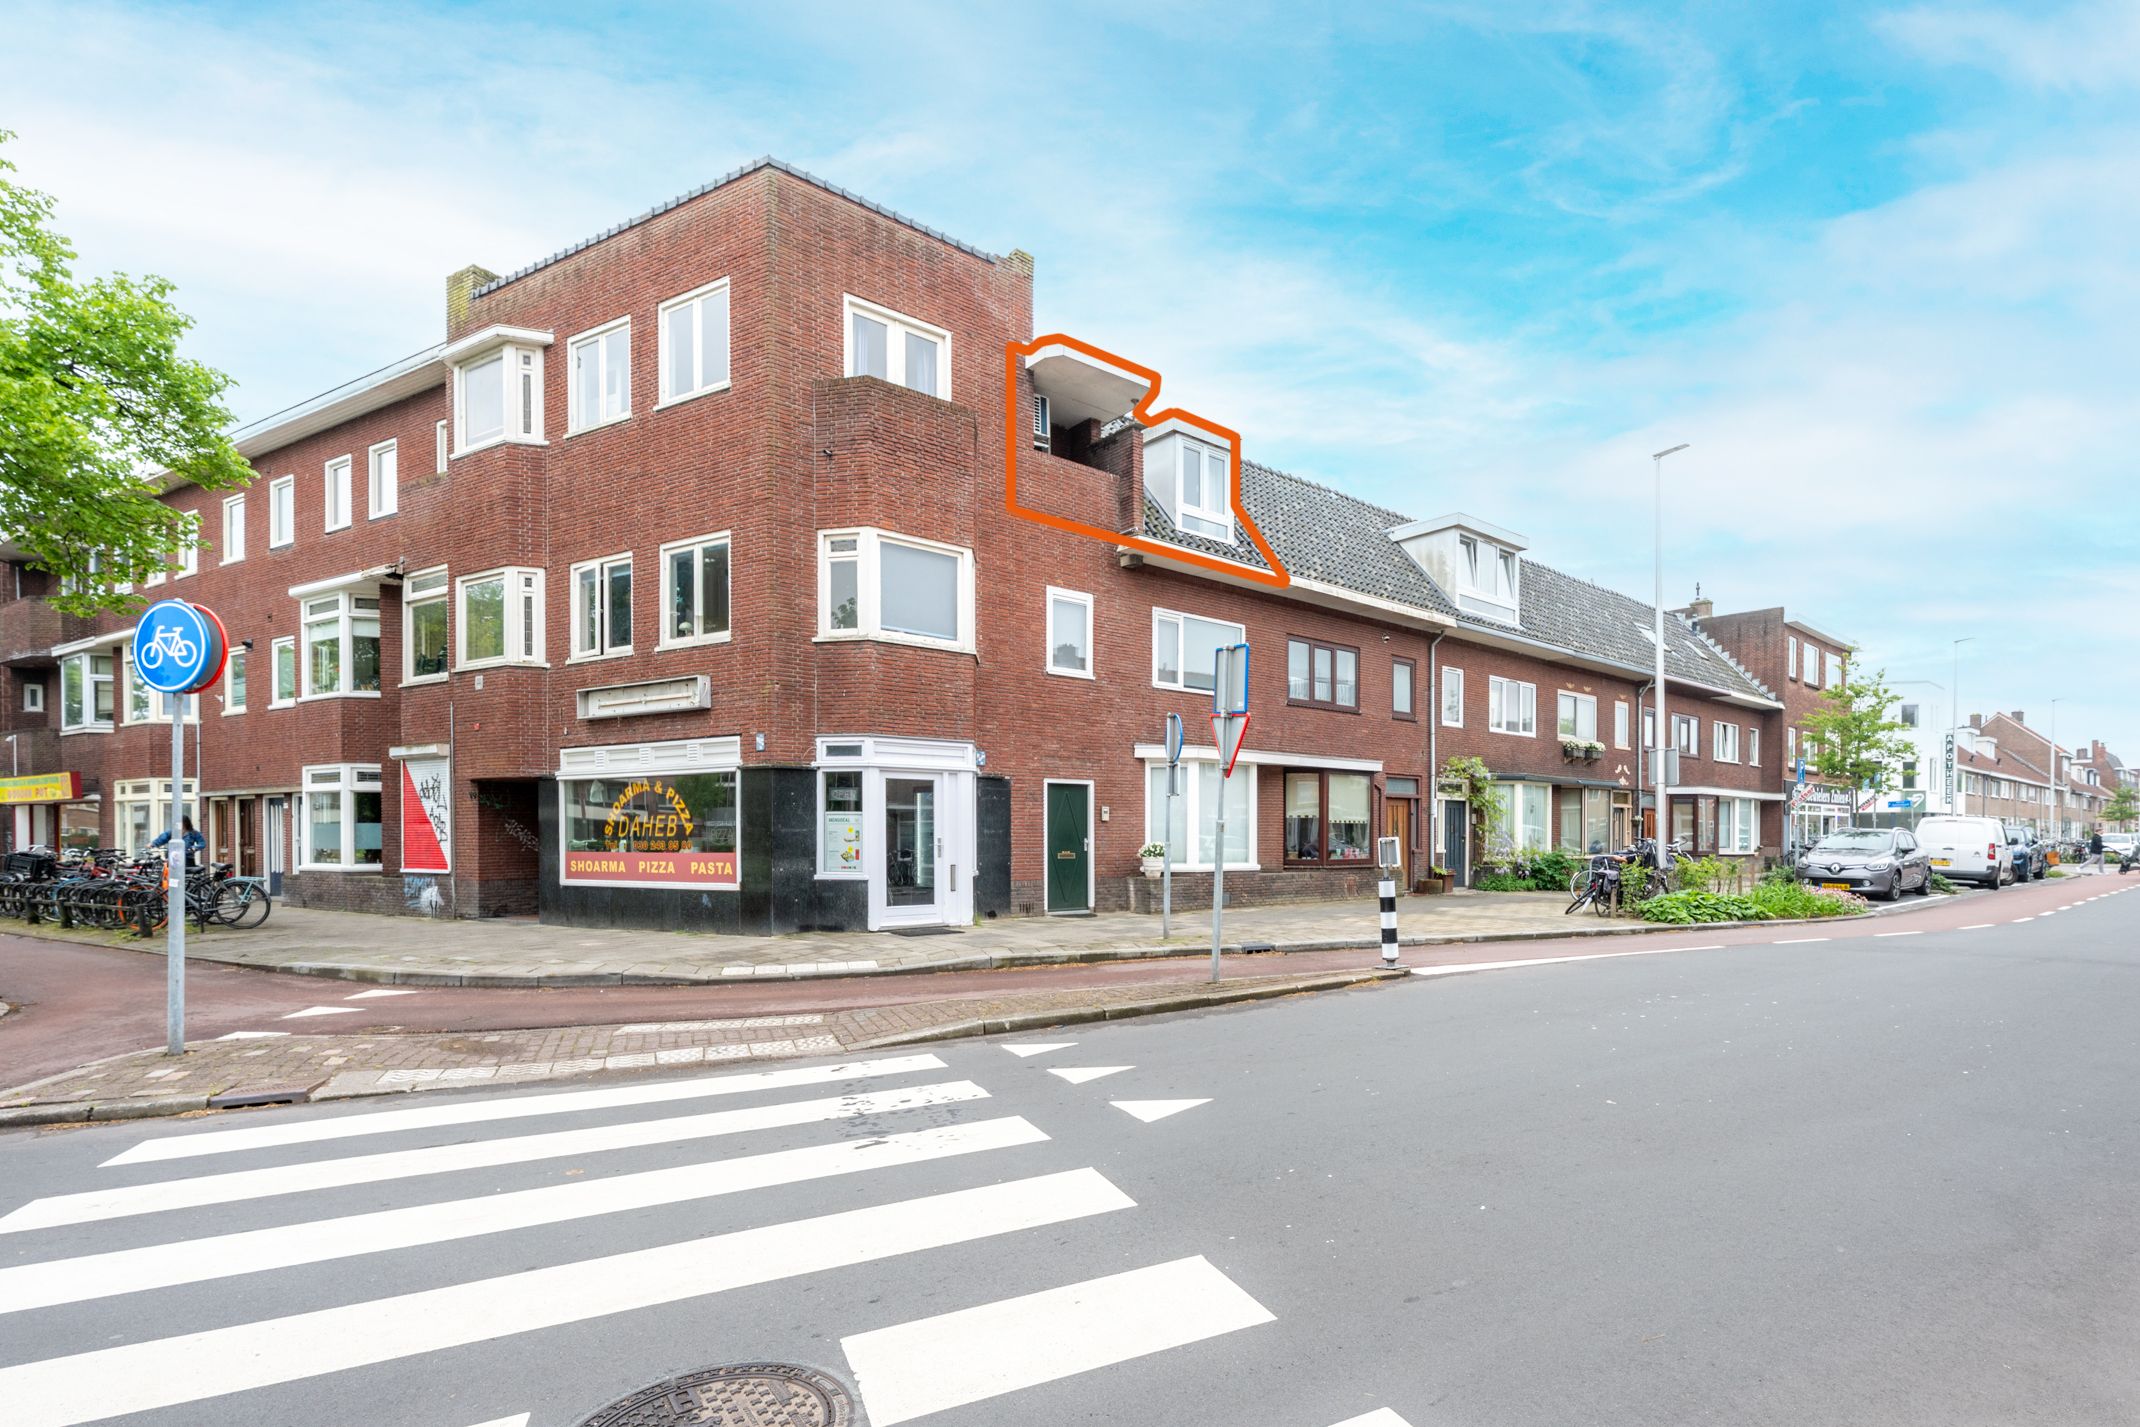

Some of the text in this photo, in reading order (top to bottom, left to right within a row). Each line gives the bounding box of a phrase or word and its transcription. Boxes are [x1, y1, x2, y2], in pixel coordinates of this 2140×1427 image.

[604, 780, 694, 836] SHOARMA & PIZZA
[618, 814, 678, 837] DAHEB
[633, 840, 648, 851] 030
[570, 860, 733, 875] SHOARMA PIZZA PASTA
